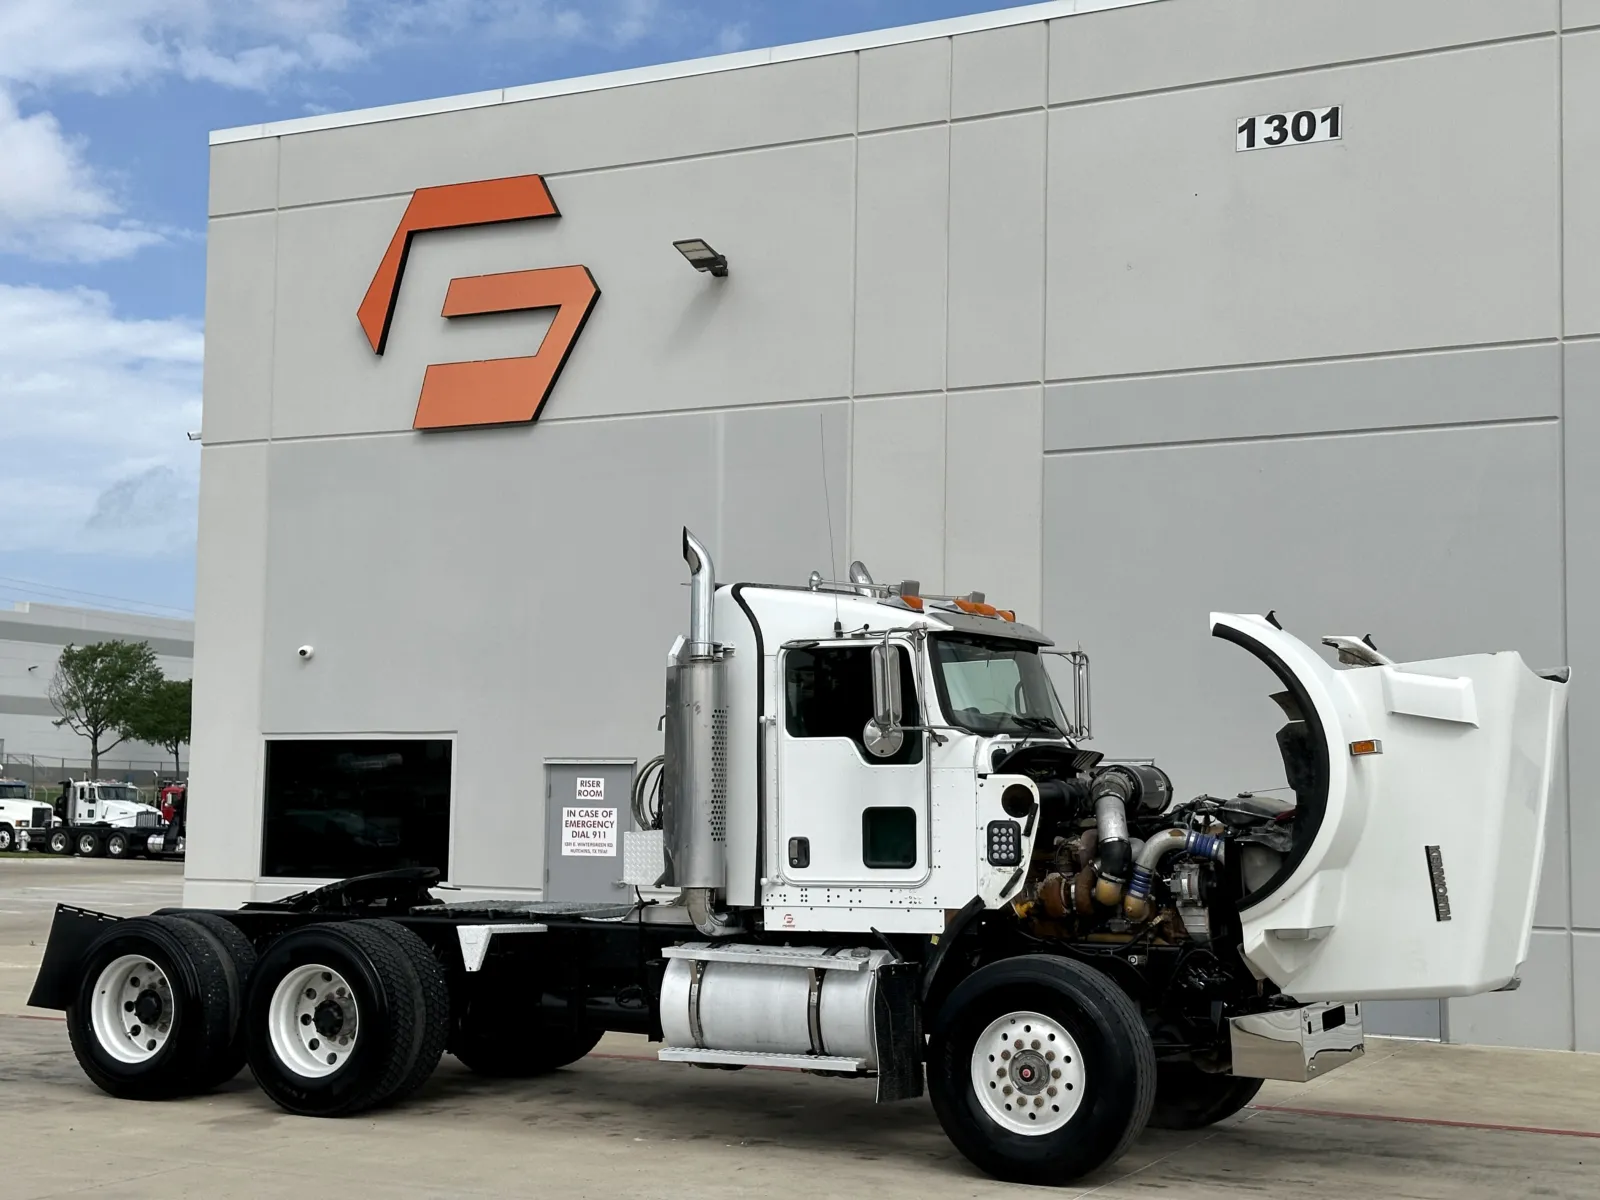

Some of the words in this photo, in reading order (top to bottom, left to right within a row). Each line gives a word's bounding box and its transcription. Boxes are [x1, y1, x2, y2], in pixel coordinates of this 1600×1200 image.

[1238, 106, 1340, 149] 1301
[578, 790, 602, 798] ROOM
[578, 810, 599, 818] CASE
[565, 820, 614, 828] EMERGENCY
[572, 830, 590, 838] DIAL
[1427, 845, 1452, 921] KENWORTH
